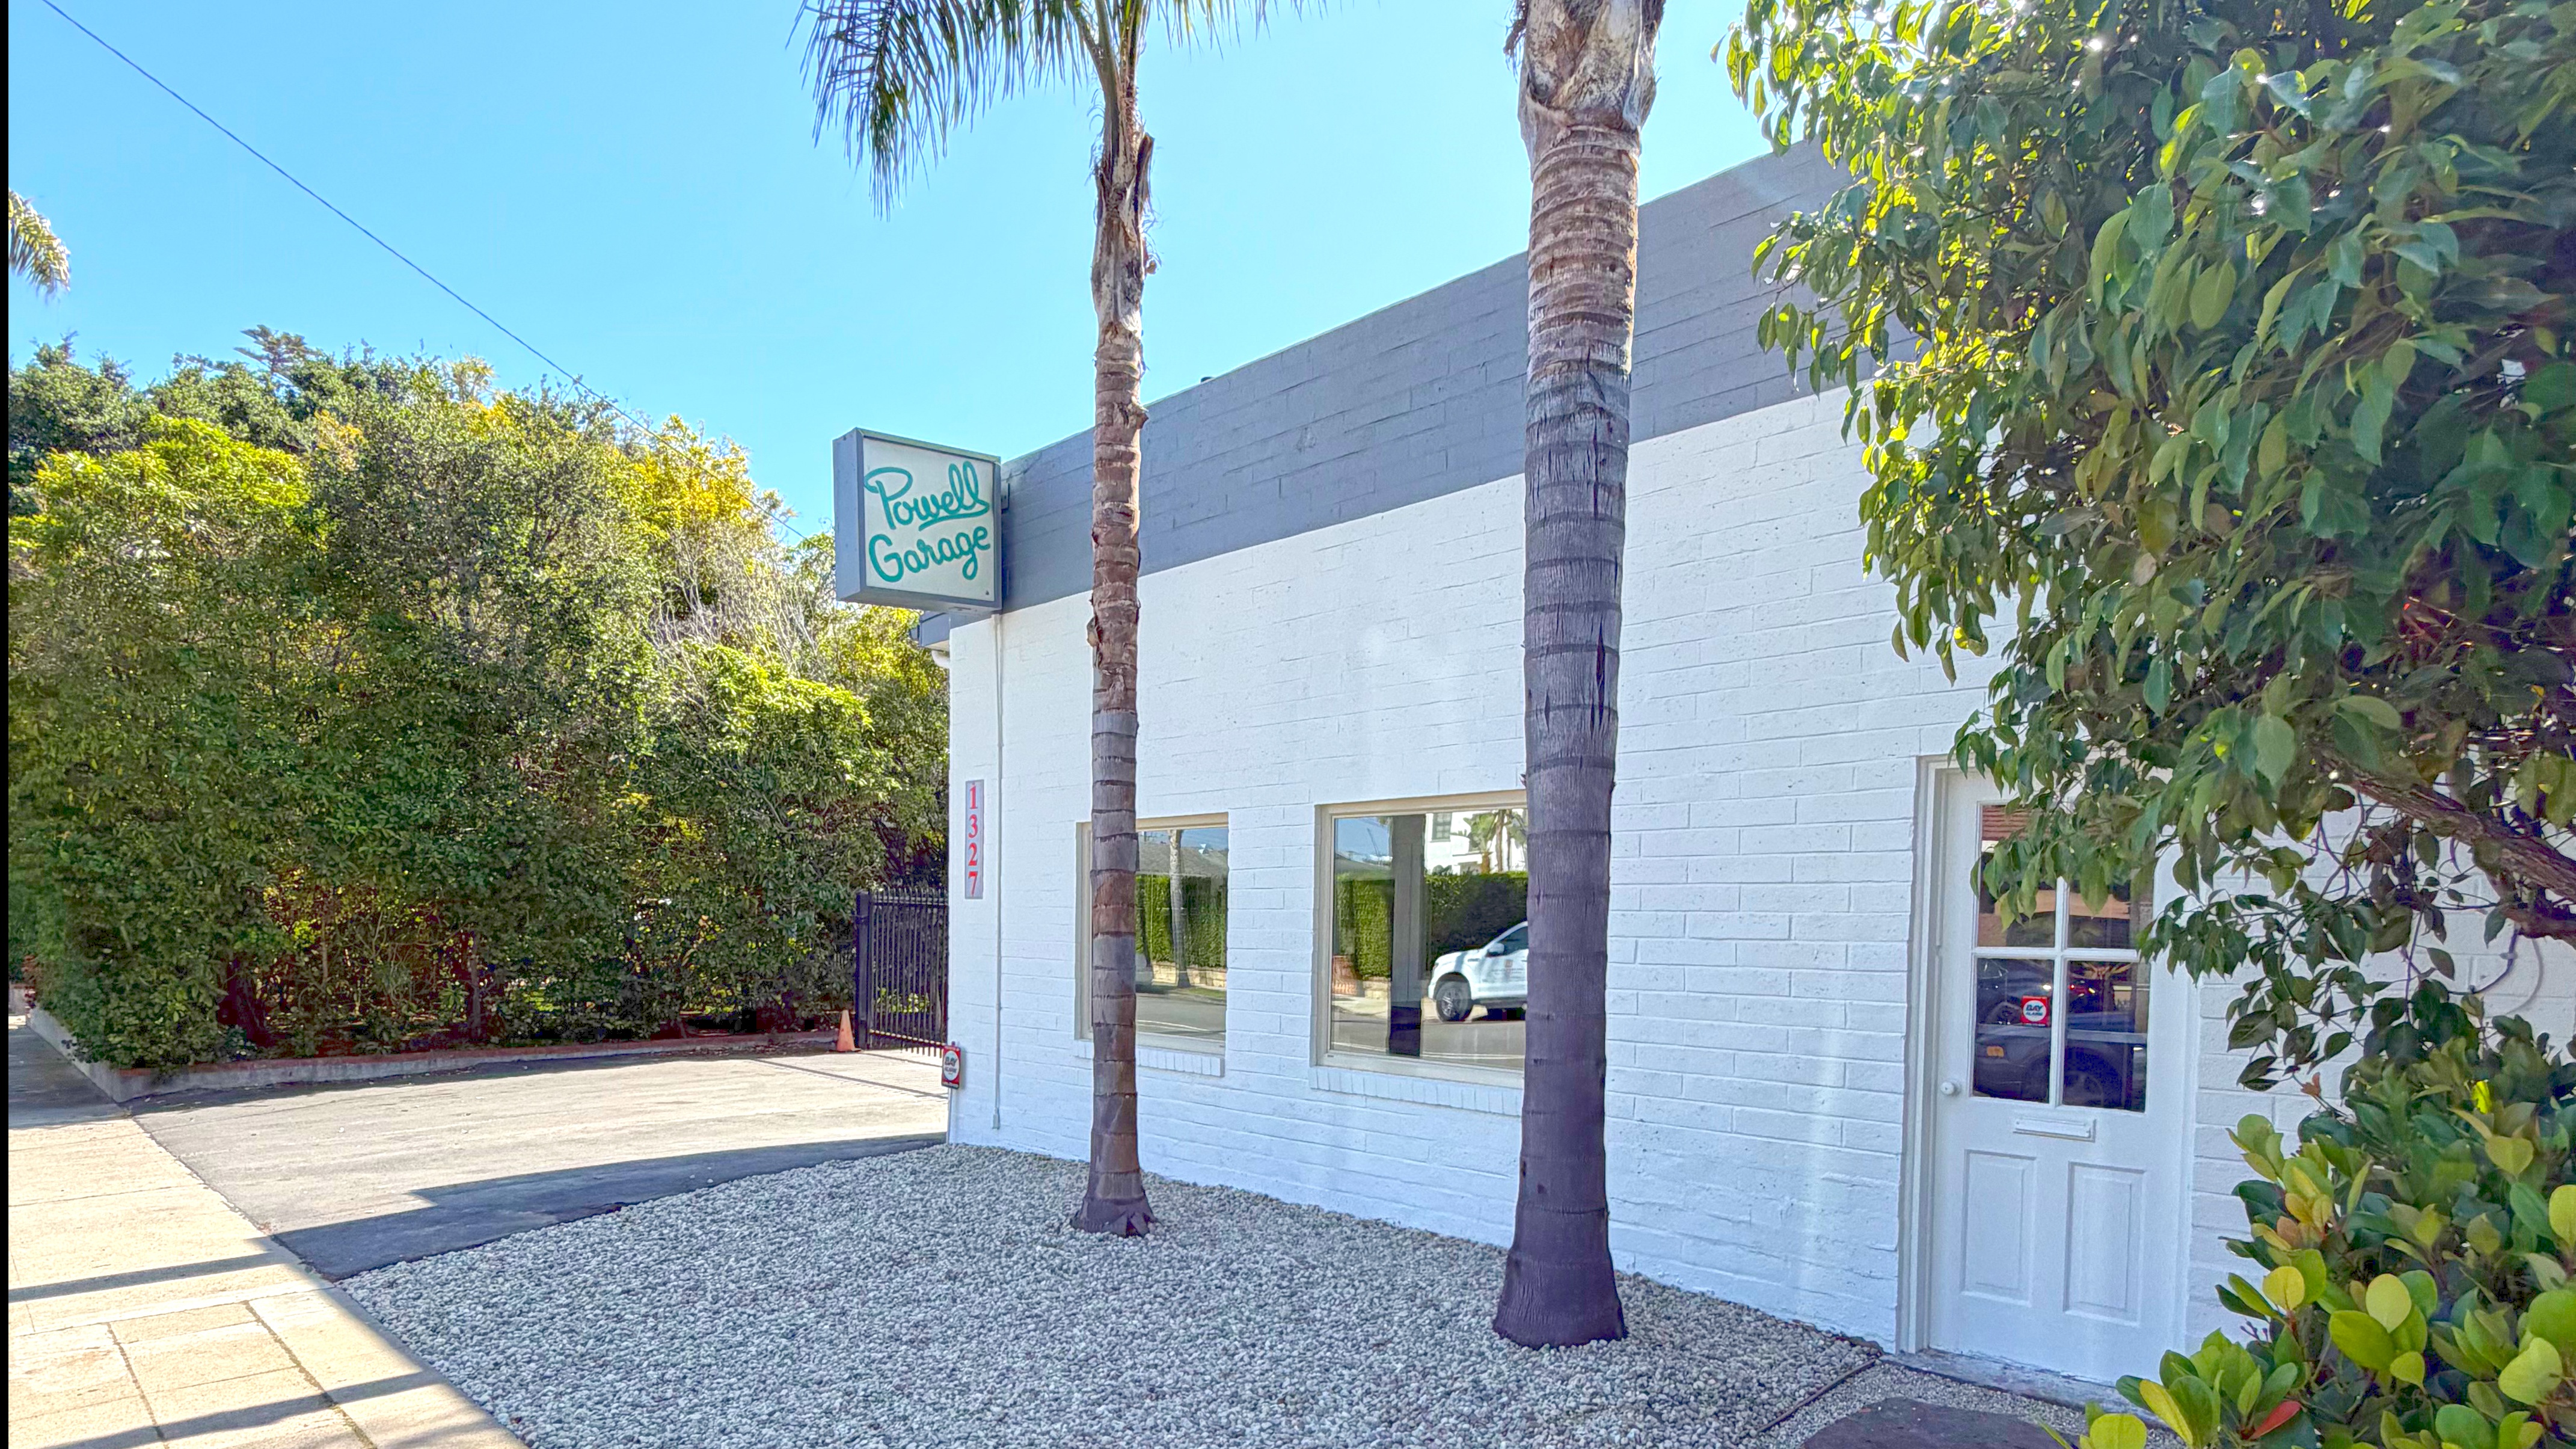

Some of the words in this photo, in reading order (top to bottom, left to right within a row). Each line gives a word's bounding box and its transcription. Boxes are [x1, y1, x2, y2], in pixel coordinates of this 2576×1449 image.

[863, 461, 990, 531] Powell
[869, 526, 990, 583] Garage
[968, 785, 978, 896] 1327
